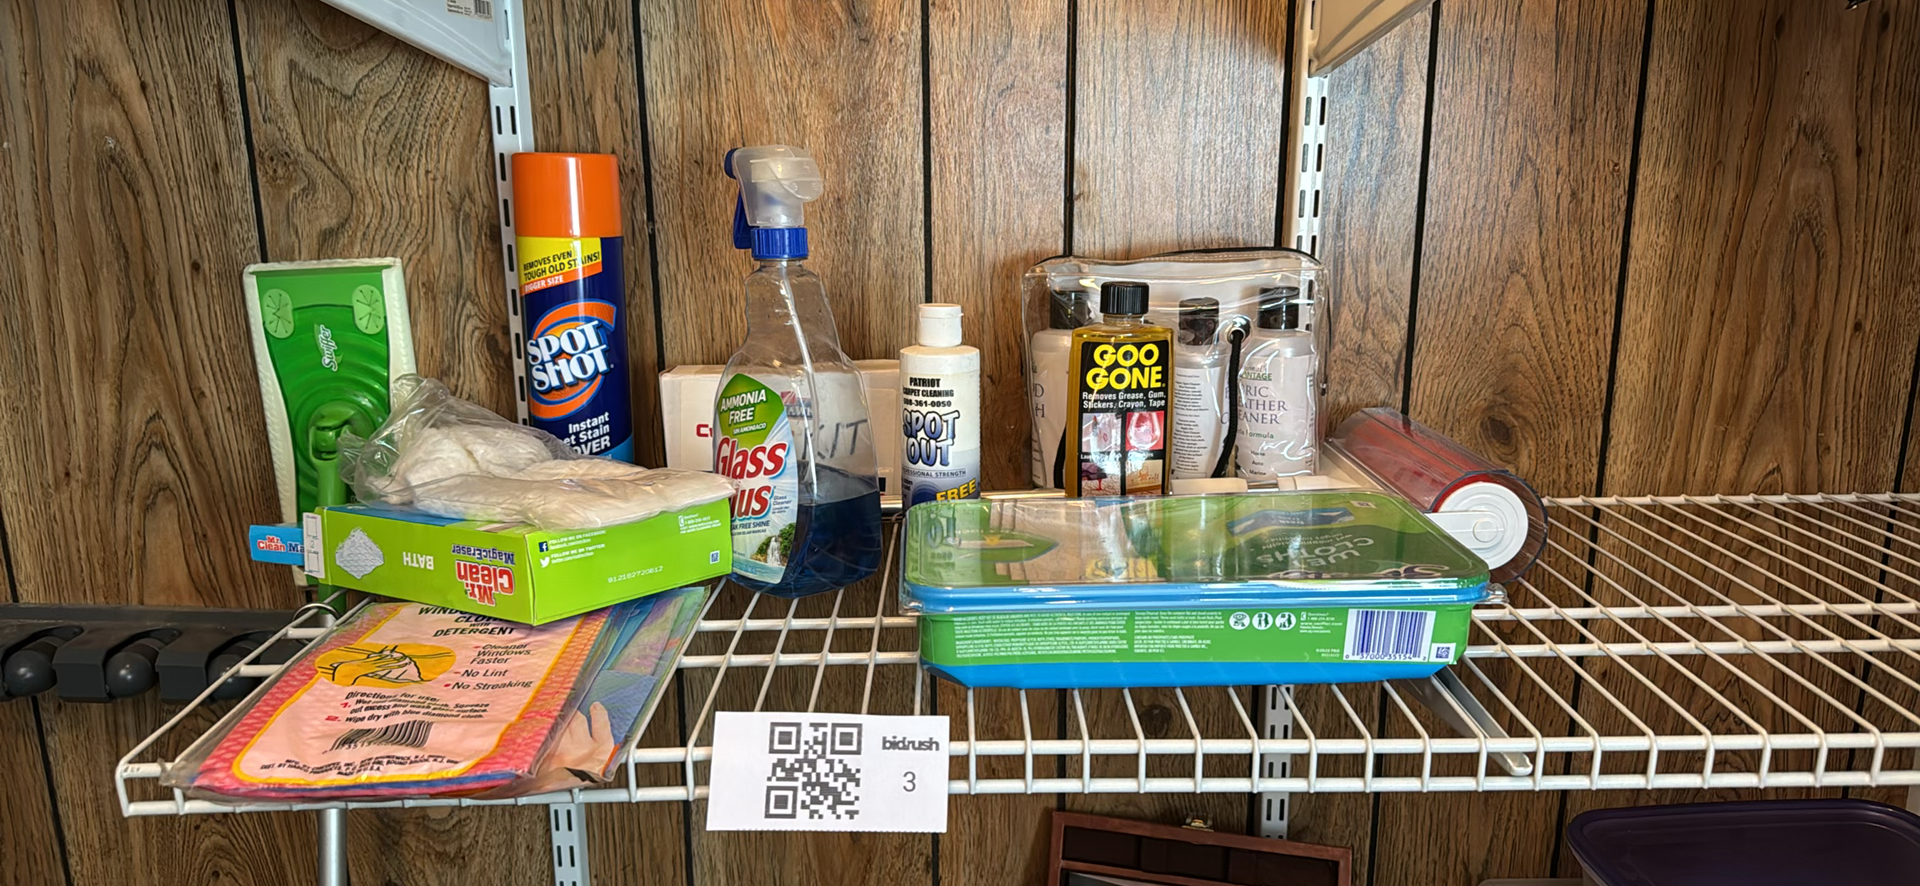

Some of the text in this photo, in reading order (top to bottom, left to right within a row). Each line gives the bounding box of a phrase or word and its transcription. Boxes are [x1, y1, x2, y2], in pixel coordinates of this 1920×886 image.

[523, 250, 572, 271] REMOVES EVEN
[524, 267, 547, 281] TOUGH
[548, 262, 566, 274] OLD
[525, 274, 564, 293] BIGGER SIZE
[319, 324, 338, 371] Swiffer
[527, 320, 600, 365] SPOT
[1093, 343, 1159, 367] GOO
[531, 344, 608, 391] SHOT
[909, 377, 941, 387] PATRIOT
[1086, 366, 1162, 390] GONE
[720, 389, 767, 412] AMMONIA
[921, 389, 954, 397] CLEANING
[1082, 390, 1167, 400] Removes Grease, Gum,
[1082, 399, 1166, 409] Stickers, Crayon, Tape
[568, 411, 609, 434] Instant
[728, 407, 755, 426] FREE
[903, 408, 960, 441] SPOT
[578, 424, 610, 443] Stain
[733, 427, 741, 435] SIN
[716, 436, 787, 480] Glass
[907, 437, 955, 466] OUT
[936, 478, 977, 501] FREE
[731, 485, 772, 518] lus
[739, 522, 751, 530] FREE
[752, 520, 770, 529] SHINE
[257, 540, 286, 552] Clean
[402, 551, 434, 570] BATH
[455, 561, 515, 595] Clean
[465, 582, 495, 606] Mr.
[433, 627, 516, 637] DETERGENT
[470, 657, 511, 665] Faster
[477, 649, 531, 658] Windows
[461, 669, 508, 677] No Lint
[451, 680, 534, 690] No Streaking
[345, 691, 398, 700] Directions
[350, 706, 363, 714] out
[367, 713, 383, 722] dry
[383, 710, 401, 719] with
[902, 771, 916, 792] 3
